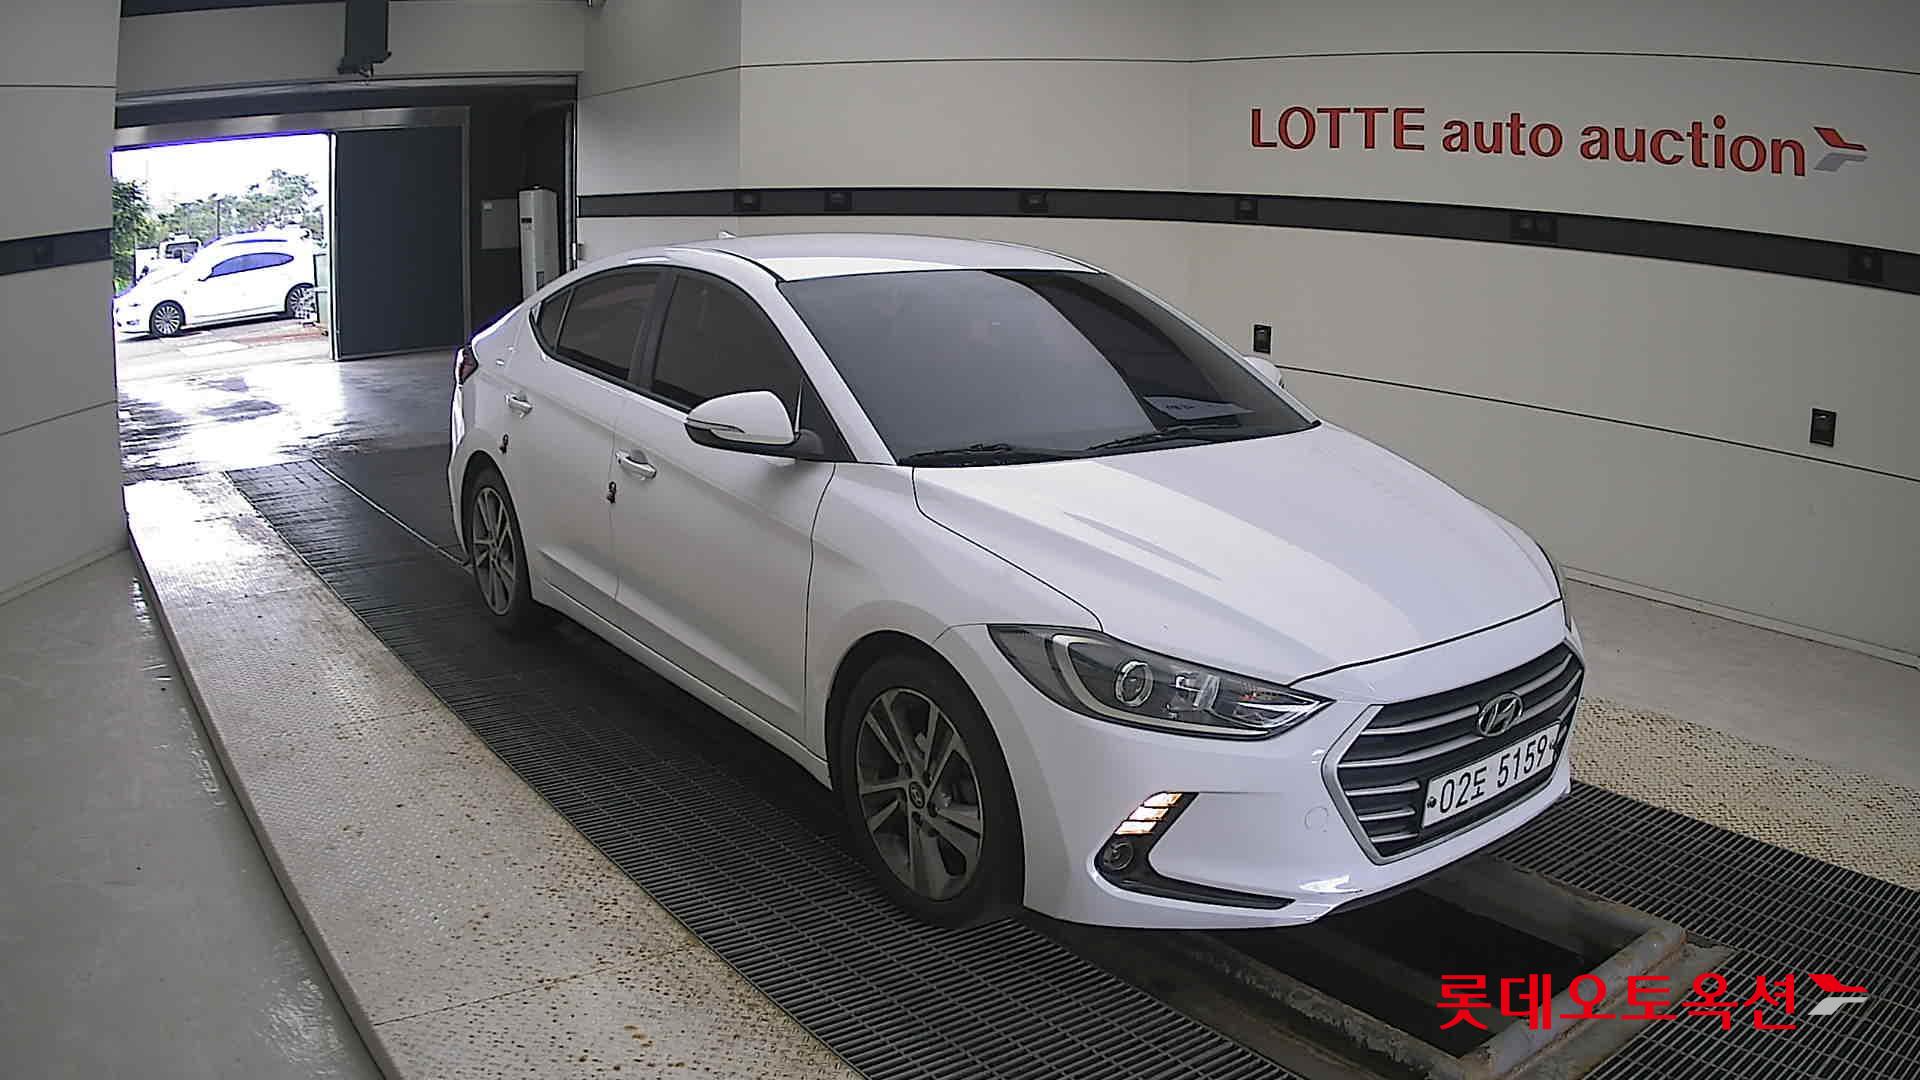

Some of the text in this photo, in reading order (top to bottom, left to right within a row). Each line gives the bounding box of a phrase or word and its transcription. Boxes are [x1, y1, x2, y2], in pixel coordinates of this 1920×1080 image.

[1251, 107, 1806, 177] LOTTE auto auction
[1439, 734, 1548, 814] 02도 5159
